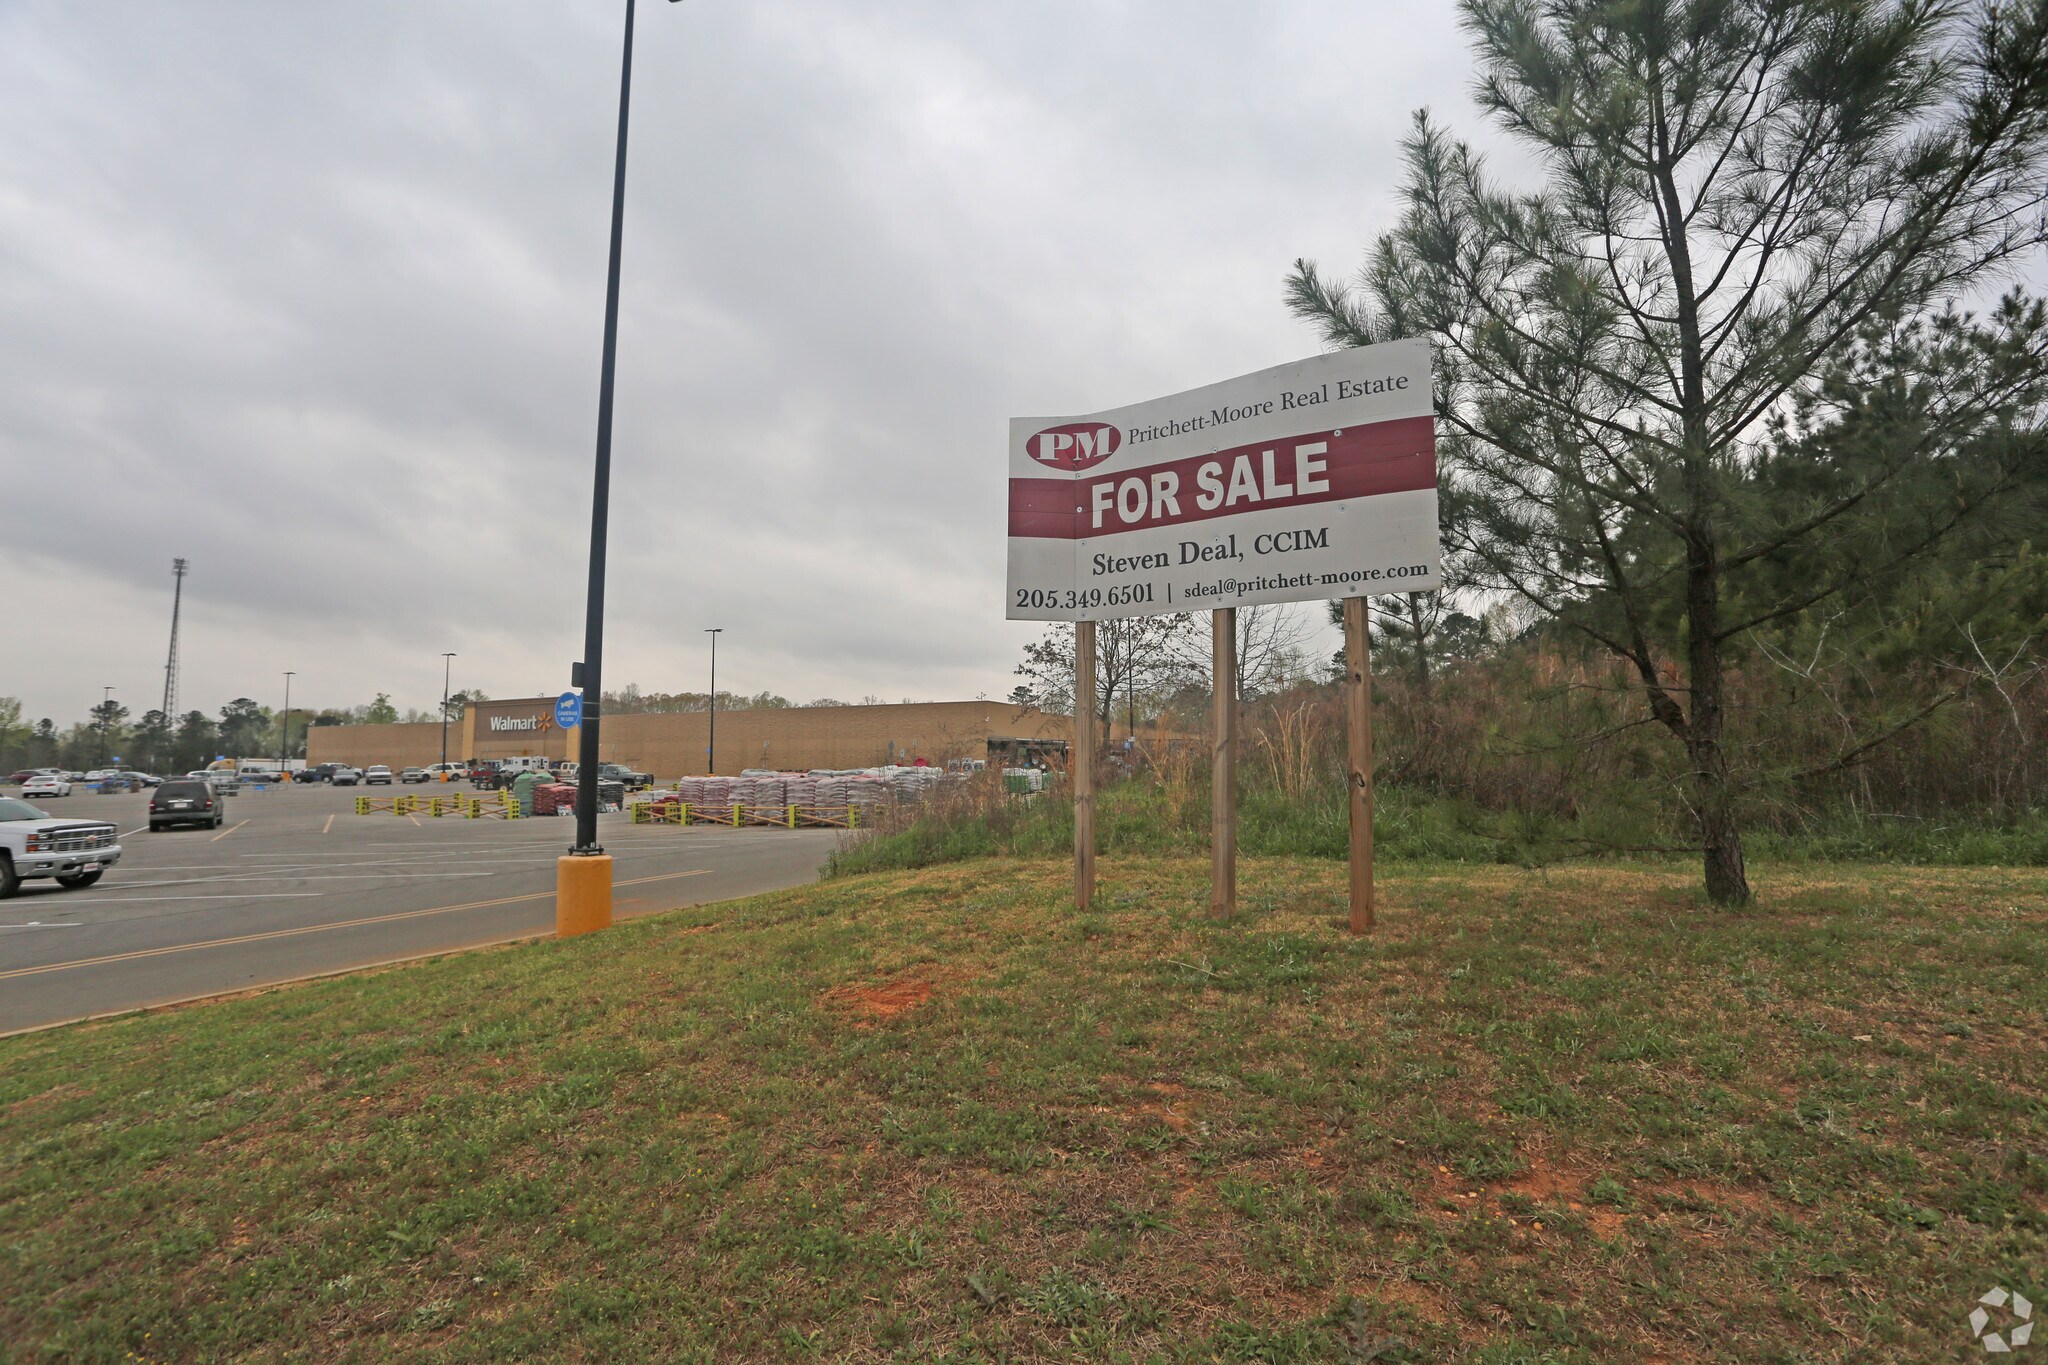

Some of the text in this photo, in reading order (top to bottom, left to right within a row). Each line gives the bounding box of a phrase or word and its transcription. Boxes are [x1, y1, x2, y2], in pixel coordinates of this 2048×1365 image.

[1128, 375, 1409, 446] Pritchett-Moore Real Estate
[1037, 426, 1113, 461] PM
[1092, 441, 1330, 529] FOR SALE
[1092, 527, 1330, 576] Steven Deal, CCIM
[1016, 583, 1154, 609] 205.349.6501
[1184, 563, 1429, 598] sdeal@pritchett-moore.com
[490, 715, 537, 731] Walmart
